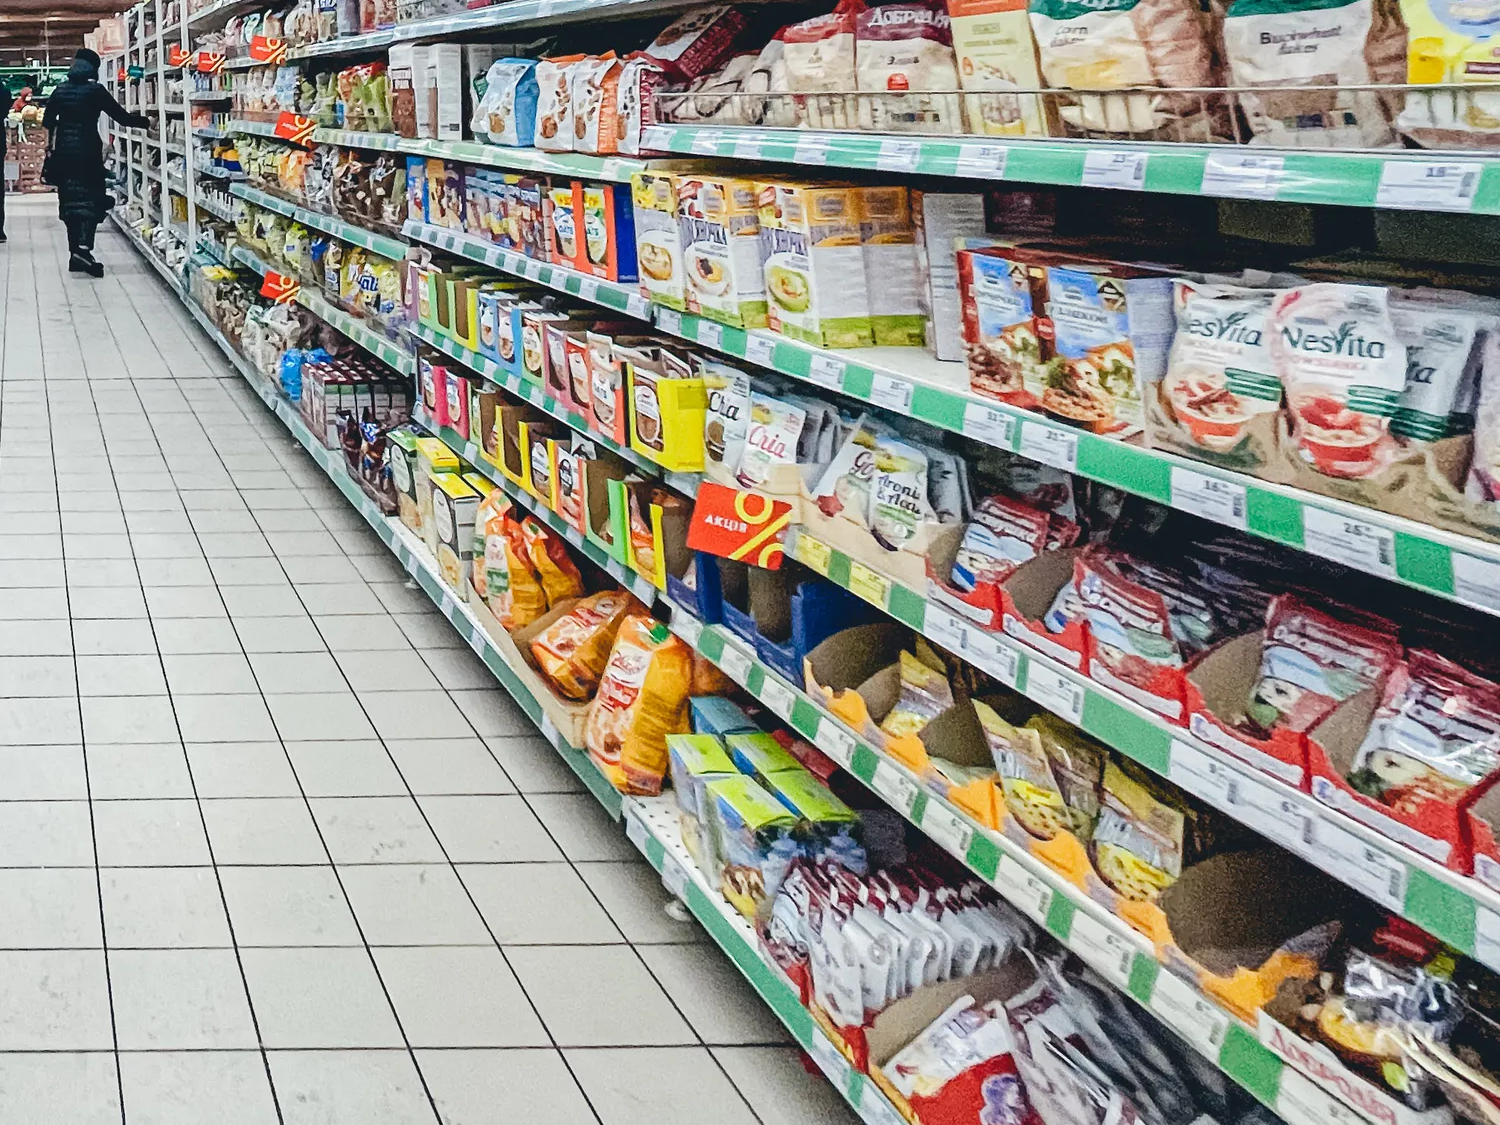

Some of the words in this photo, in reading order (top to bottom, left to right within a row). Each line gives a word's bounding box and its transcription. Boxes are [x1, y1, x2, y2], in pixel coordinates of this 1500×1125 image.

[1282, 321, 1385, 360] NesVita
[709, 391, 741, 421] Chia
[878, 474, 921, 500] Aroni
[704, 513, 749, 534] АКЦІЯ
